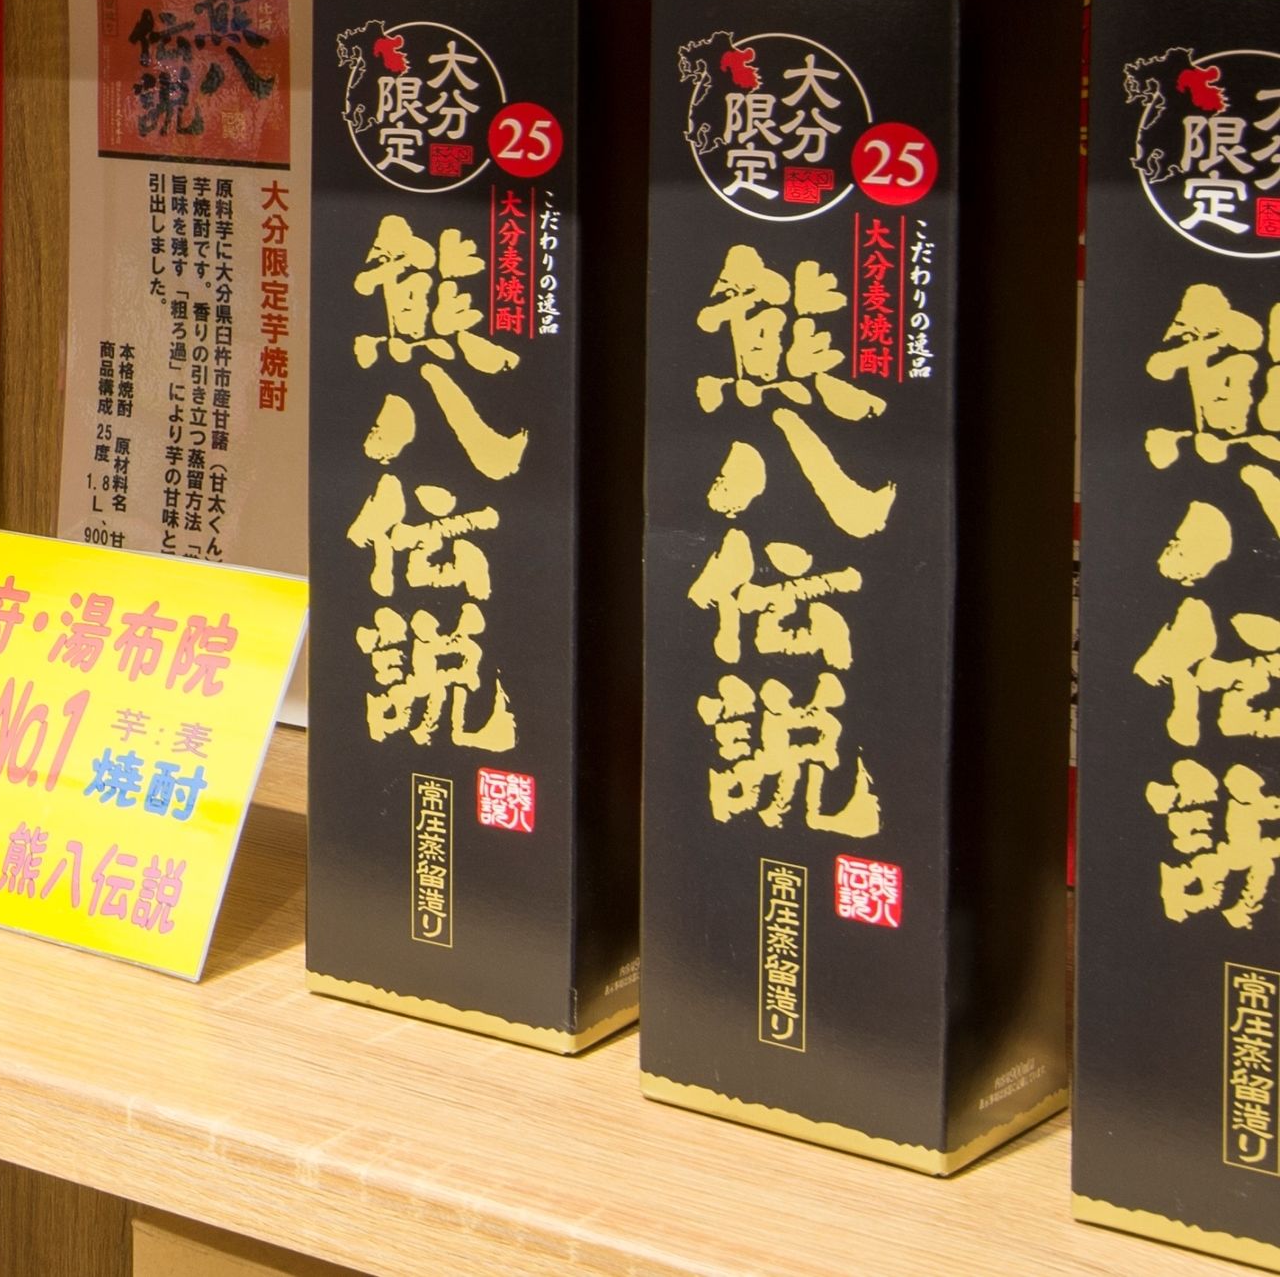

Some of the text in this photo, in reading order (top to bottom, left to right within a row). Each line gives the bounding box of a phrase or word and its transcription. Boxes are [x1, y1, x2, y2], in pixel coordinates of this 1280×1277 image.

[128, 8, 205, 138] 伝説
[376, 76, 428, 175] 限定
[426, 40, 480, 141] 大分
[496, 118, 554, 162] 25
[781, 54, 842, 163] 大分
[723, 92, 784, 201] 限定
[861, 139, 926, 189] 25
[1179, 114, 1256, 235] 限定
[148, 172, 168, 307] 引出しました。
[258, 180, 290, 413] 大分限定芋焼酎
[495, 189, 526, 336] 大分麦焼酎
[536, 190, 561, 335] こだわりの逸品
[859, 219, 894, 378] 大分麦焼酎
[906, 220, 936, 379] こだわりの逸品
[94, 340, 116, 463] 商品構成 25度
[111, 342, 135, 514] 本格焼酎 原材料名
[347, 214, 530, 753] 熊八伝説
[688, 244, 897, 839] 熊八伝説
[83, 746, 209, 822] 焼酎
[416, 779, 449, 942] 常圧蒸留造り
[765, 866, 801, 1044] 常圧蒸留造り
[1230, 971, 1278, 1166] 常圧蒸留造り
